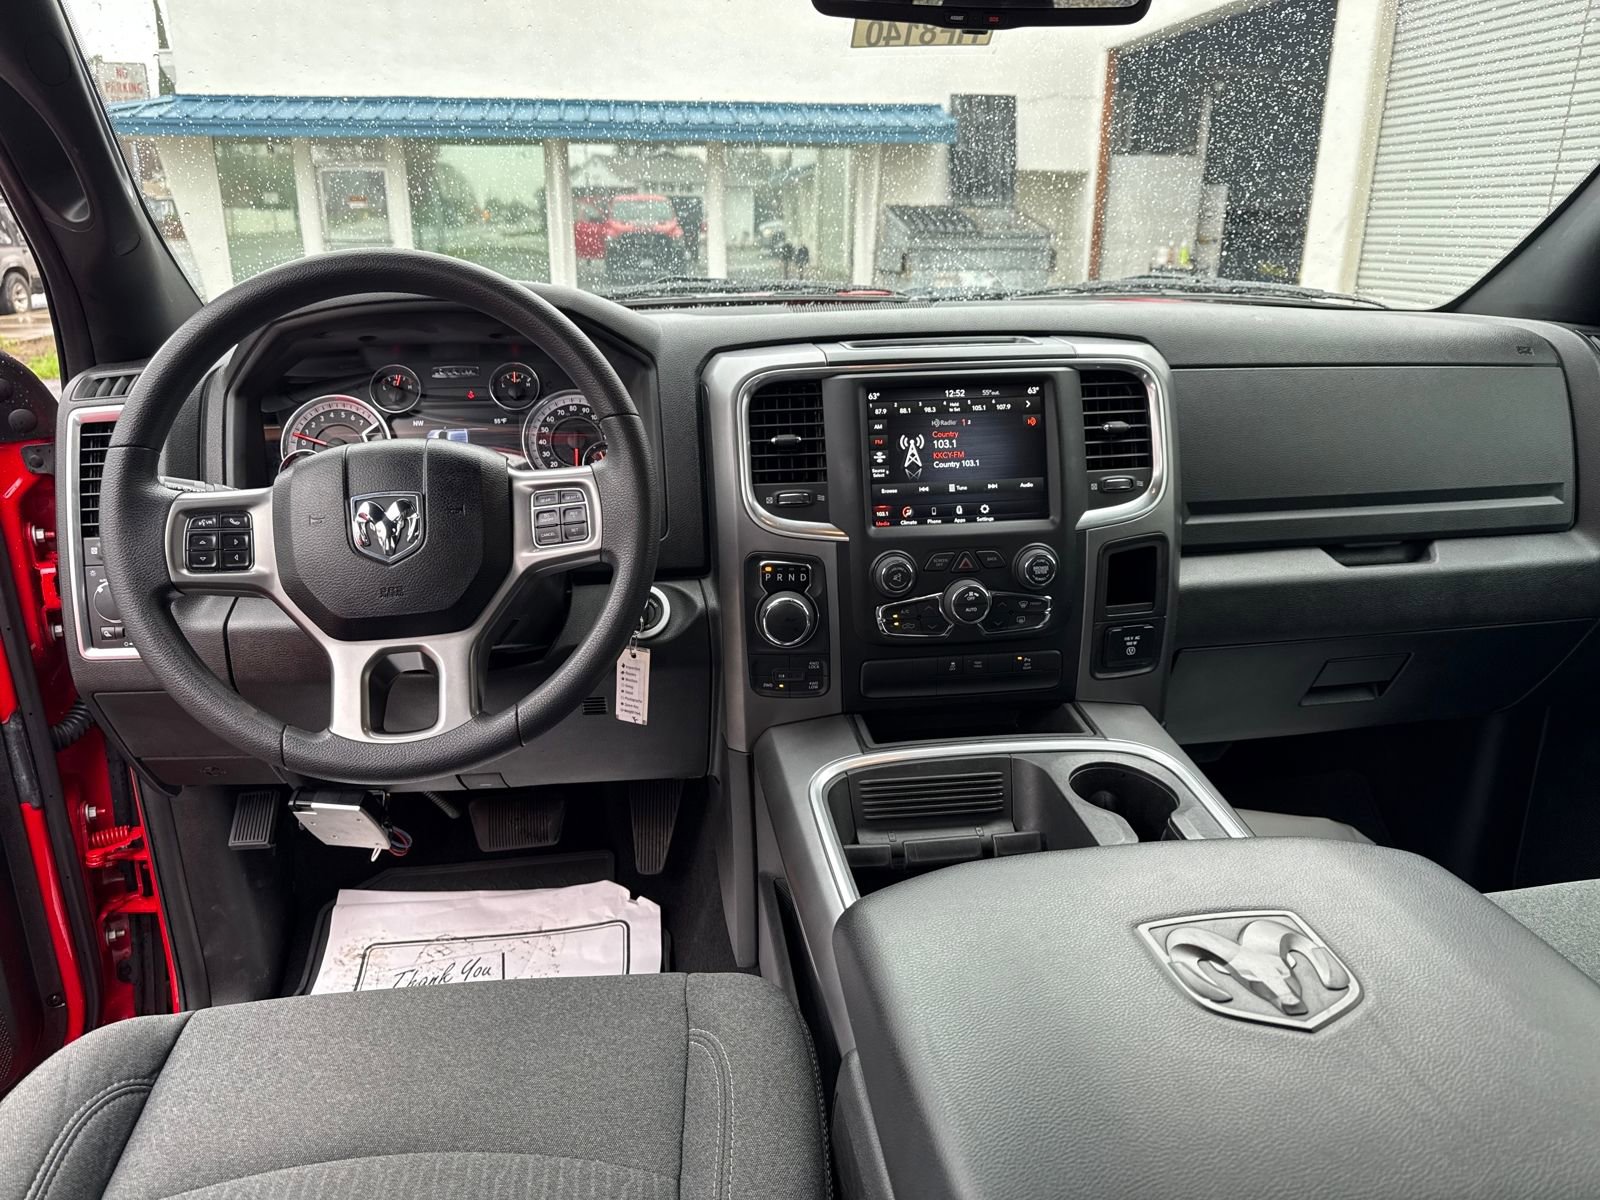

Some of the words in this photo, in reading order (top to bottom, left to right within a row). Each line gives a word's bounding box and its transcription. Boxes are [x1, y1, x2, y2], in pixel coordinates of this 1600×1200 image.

[115, 66, 128, 79] NO
[105, 82, 144, 94] PARKING
[944, 390, 966, 398] 12:52
[932, 430, 959, 439] Country
[933, 439, 957, 449] 103.1
[392, 962, 456, 988] Thank
[461, 956, 492, 982] You
